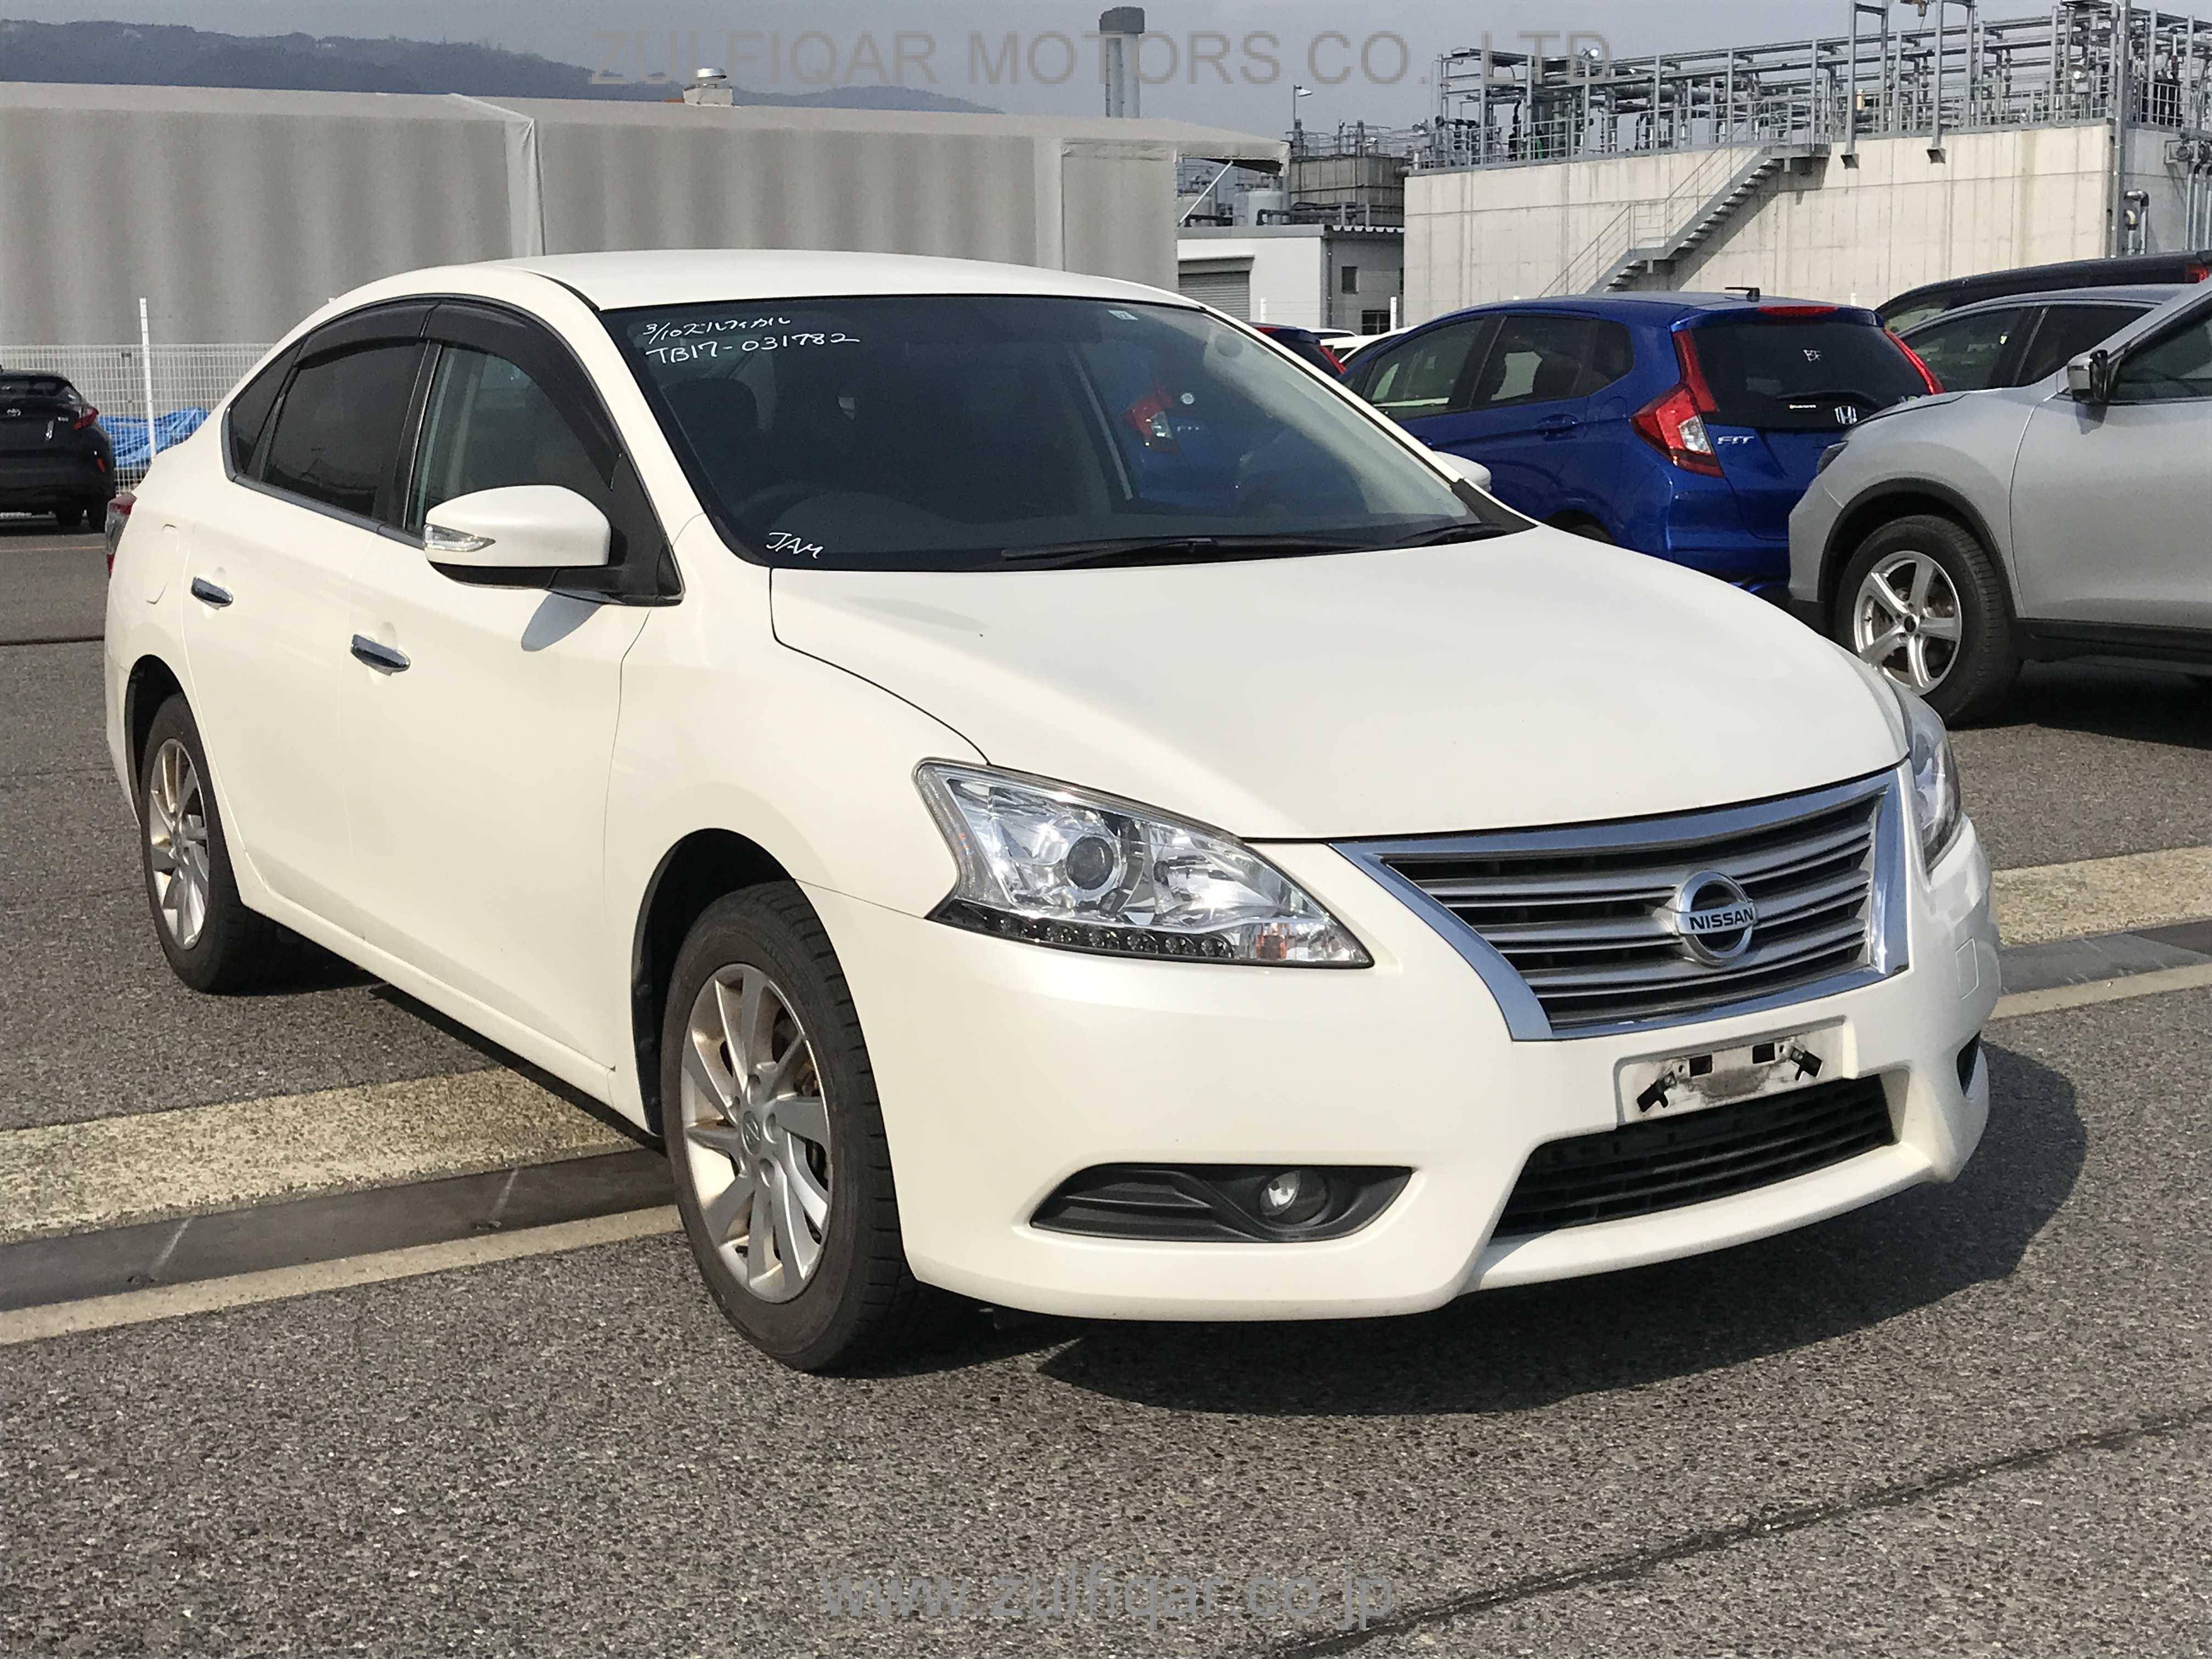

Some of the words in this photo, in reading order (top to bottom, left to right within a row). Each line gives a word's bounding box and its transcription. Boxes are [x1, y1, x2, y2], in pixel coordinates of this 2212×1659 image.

[645, 332, 860, 364] TB17-031782
[1717, 435, 1754, 444] FIT
[1689, 907, 1753, 930] NISSAN
